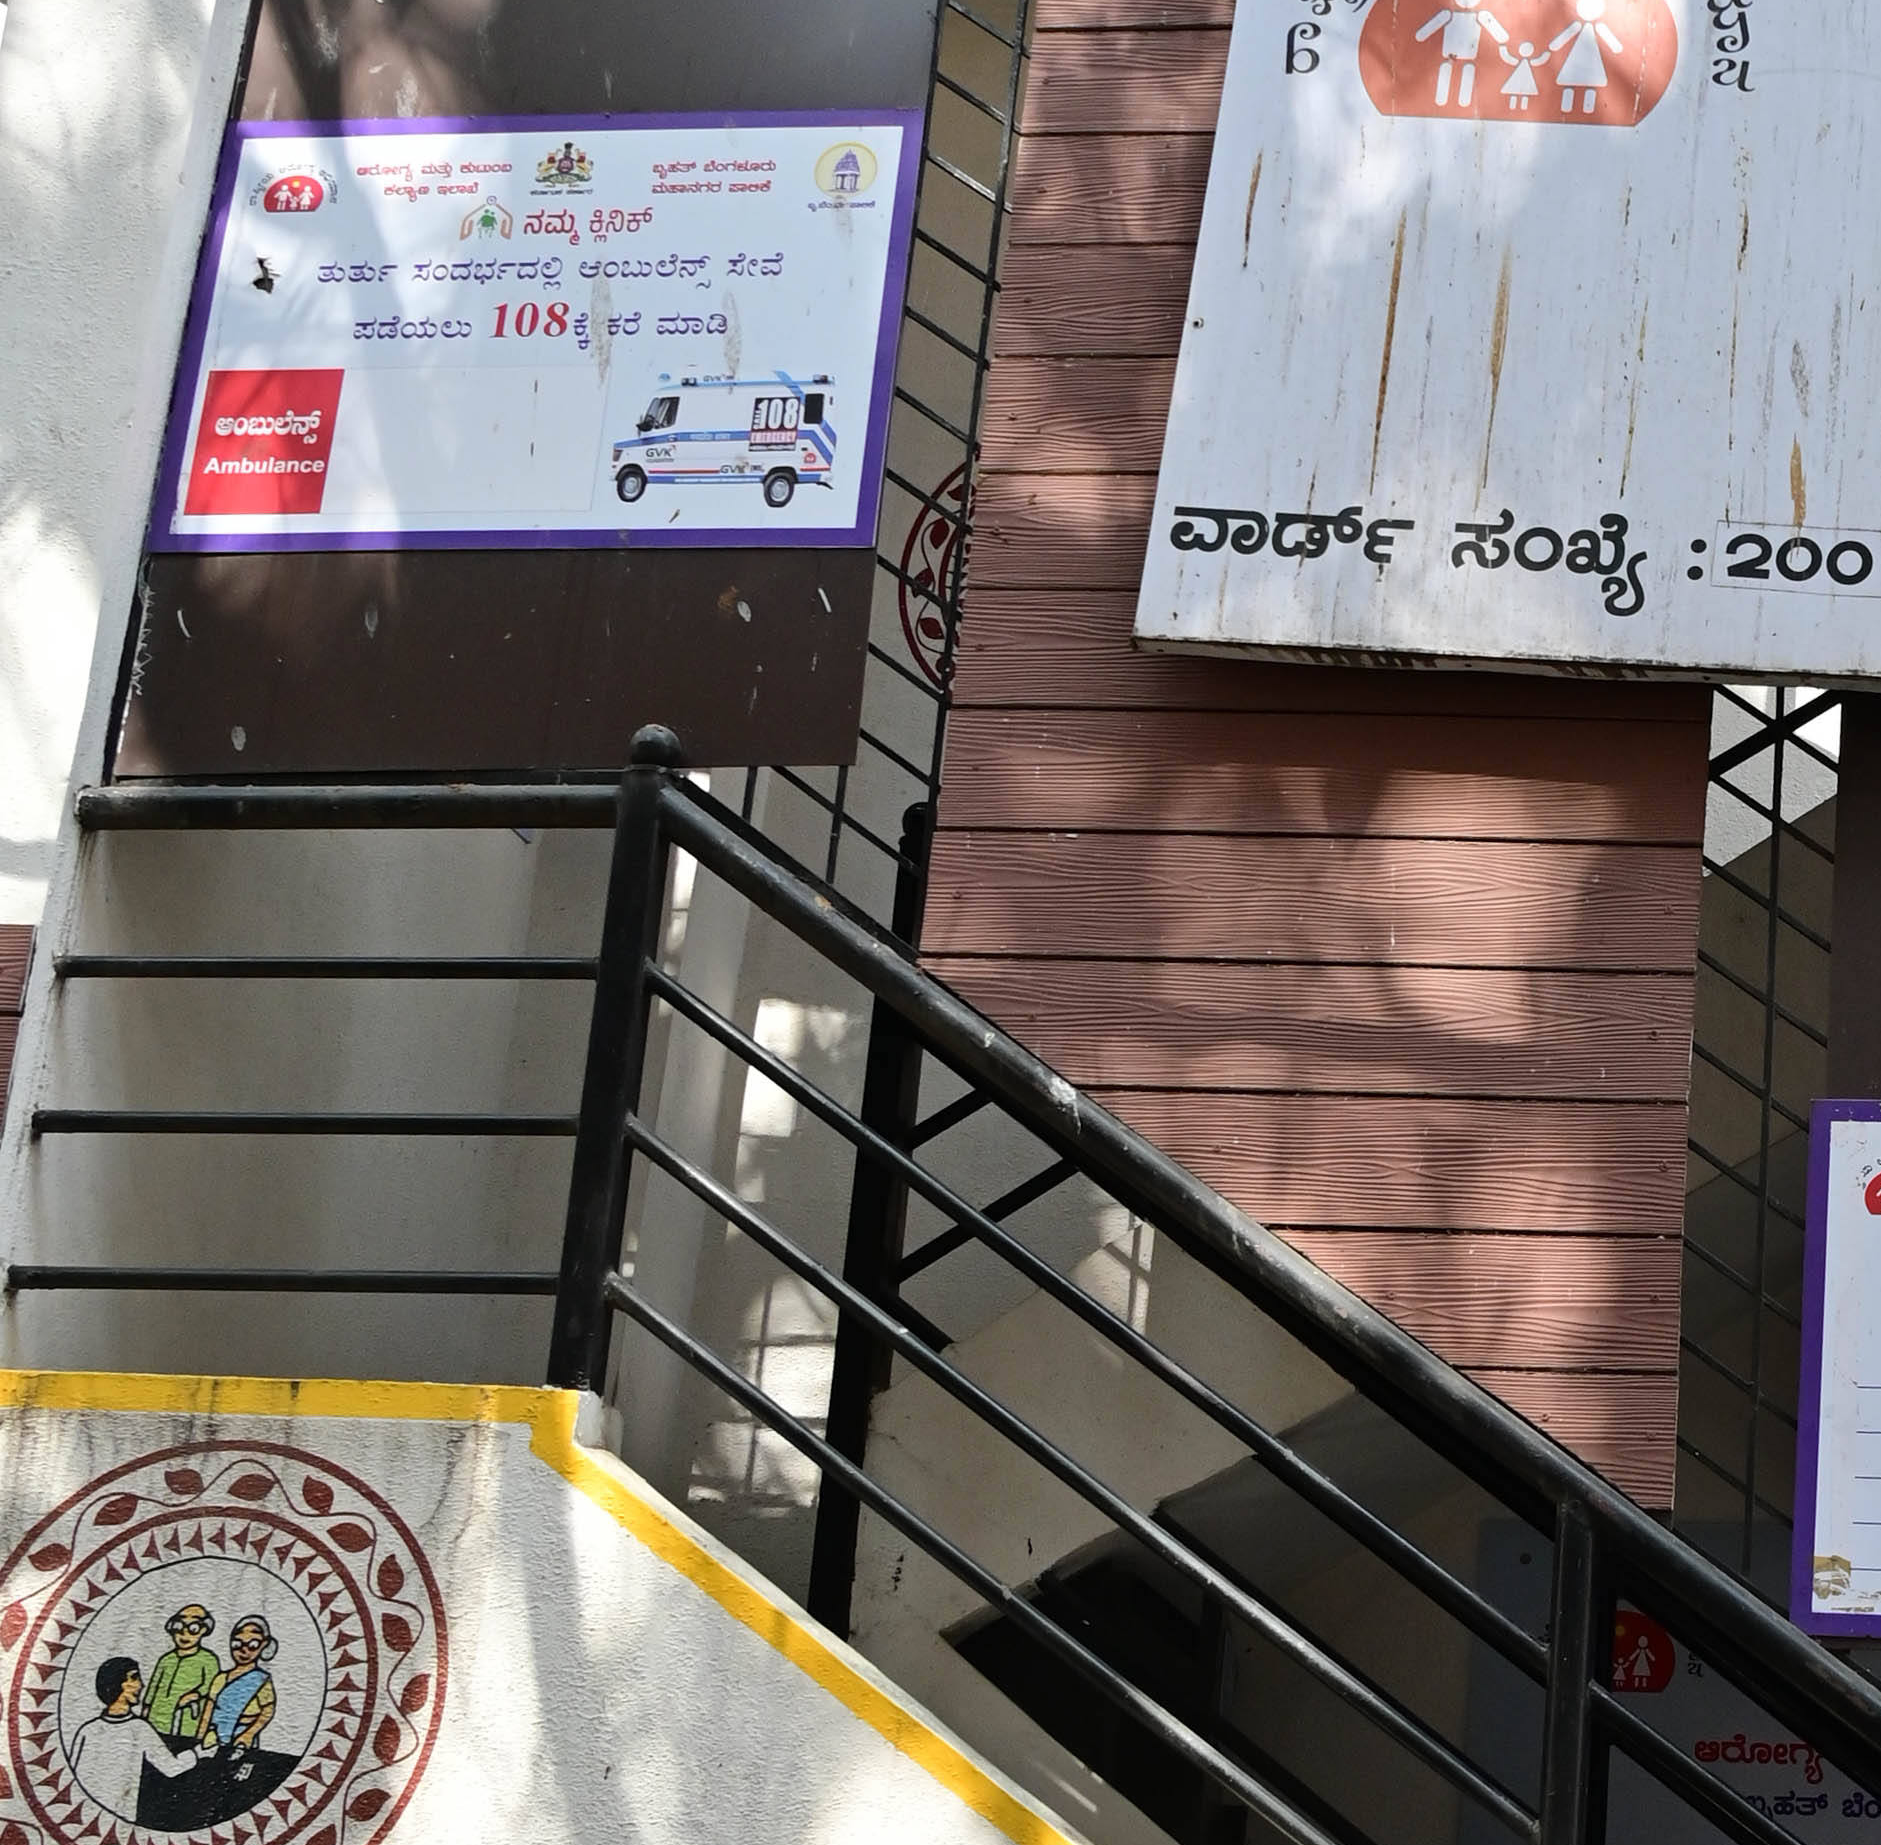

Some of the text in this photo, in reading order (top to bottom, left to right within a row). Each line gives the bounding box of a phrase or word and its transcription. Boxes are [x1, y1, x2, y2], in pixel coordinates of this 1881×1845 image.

[355, 162, 414, 182] ಆರೋಗ್ಯ
[420, 161, 453, 178] ಮತ್ತು
[652, 158, 777, 179] ಬೃಹತ್ ಬೆಂಗಳೂರು
[651, 180, 772, 195] ಮಹಾನಗರ ಪಾಲಿಕೆ
[524, 207, 654, 246] ನಮ್ಮ ಕ್ಲಿನಿಕ್
[411, 257, 565, 290] ಸಂದರ್ಭದಲ್ಲಿ
[726, 251, 785, 279] ಸೇವೆ
[352, 314, 473, 341] ಪಡೆಯಲು
[606, 312, 643, 337] ಕರೆ
[656, 310, 730, 337] ಮಾಡಿ
[758, 398, 799, 430] 108
[203, 456, 326, 475] Ambulance
[1169, 504, 1415, 564] ವಾರ್ಡ್
[1451, 508, 1648, 618] ಸಂಖ್ಯೆ
